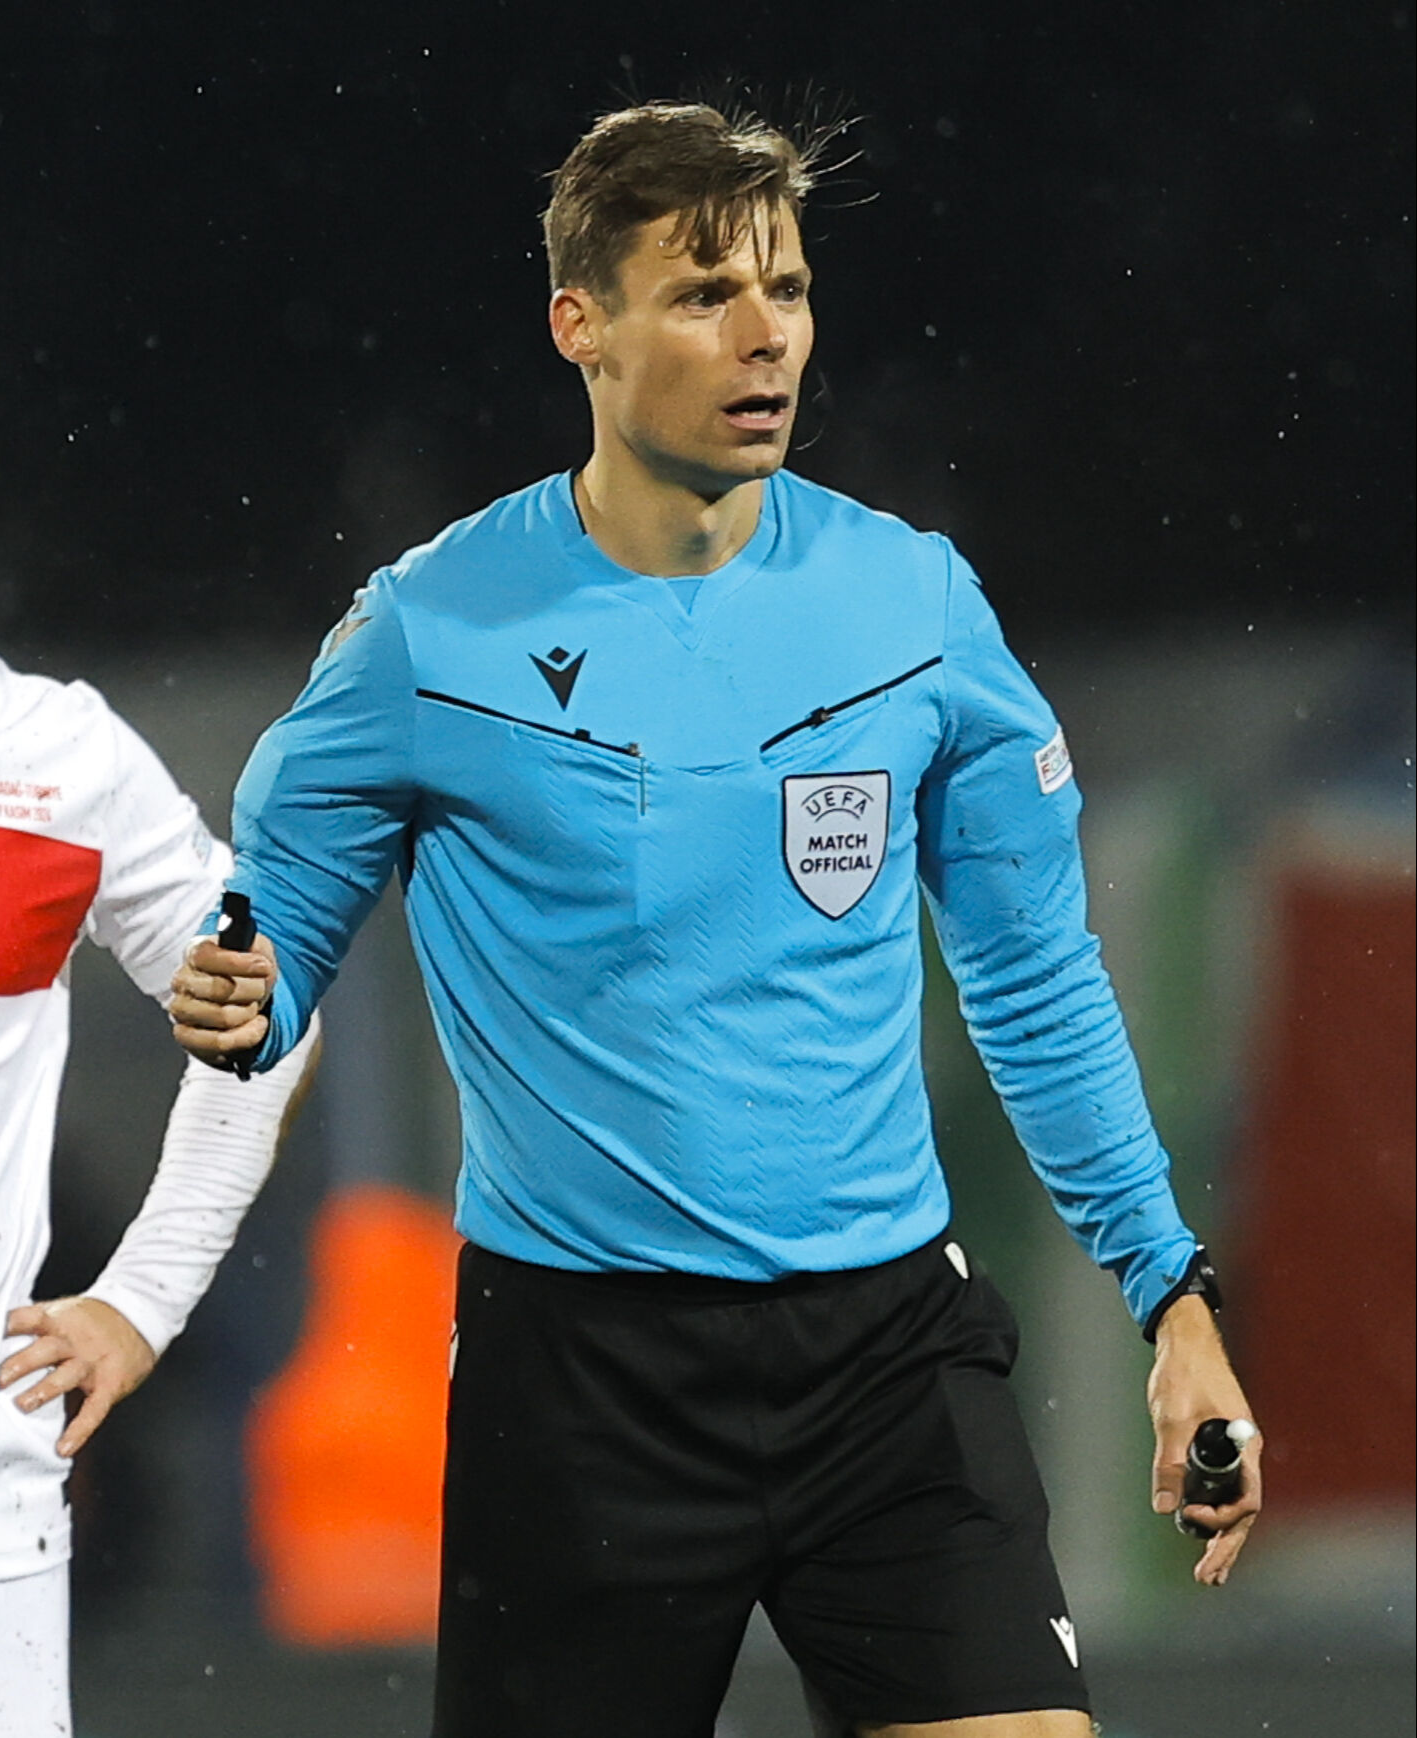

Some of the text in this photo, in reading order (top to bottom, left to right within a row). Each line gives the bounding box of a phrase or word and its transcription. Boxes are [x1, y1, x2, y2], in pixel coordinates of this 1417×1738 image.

[805, 791, 868, 816] UEFA
[808, 833, 868, 852] MATCH
[800, 855, 873, 875] OFFICIAL
